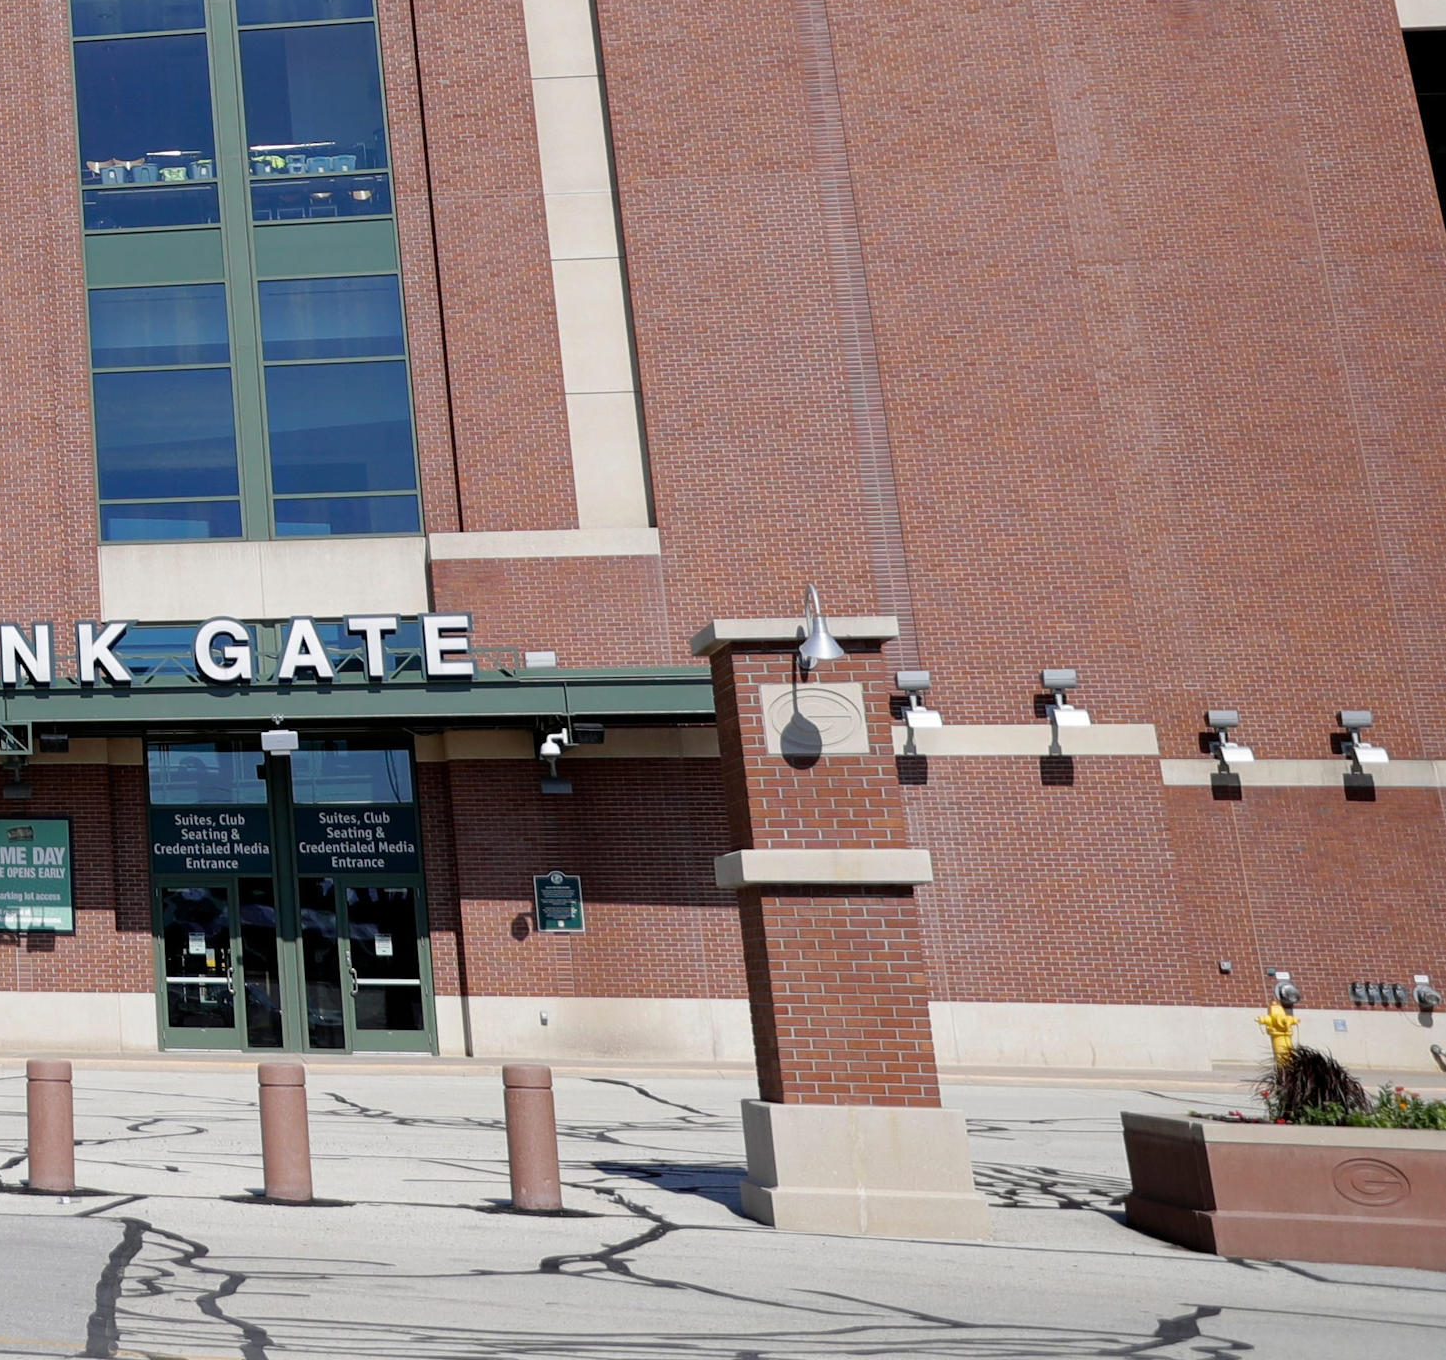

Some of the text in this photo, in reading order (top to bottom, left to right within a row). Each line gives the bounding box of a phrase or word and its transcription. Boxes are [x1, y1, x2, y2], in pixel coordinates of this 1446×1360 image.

[192, 613, 475, 683] GATE
[174, 814, 245, 827] Suites, Club
[318, 812, 390, 825] Suites, Club
[181, 828, 240, 842] Seating &
[326, 826, 385, 840] Seating &
[154, 843, 270, 855] Credentialed Media
[299, 841, 415, 853] Credentialed Media
[33, 847, 66, 865] DAY
[331, 856, 385, 868] Entrance
[185, 857, 239, 869] Entrance
[7, 867, 36, 878] OPENS
[38, 867, 66, 879] EARLY
[24, 892, 35, 900] lot
